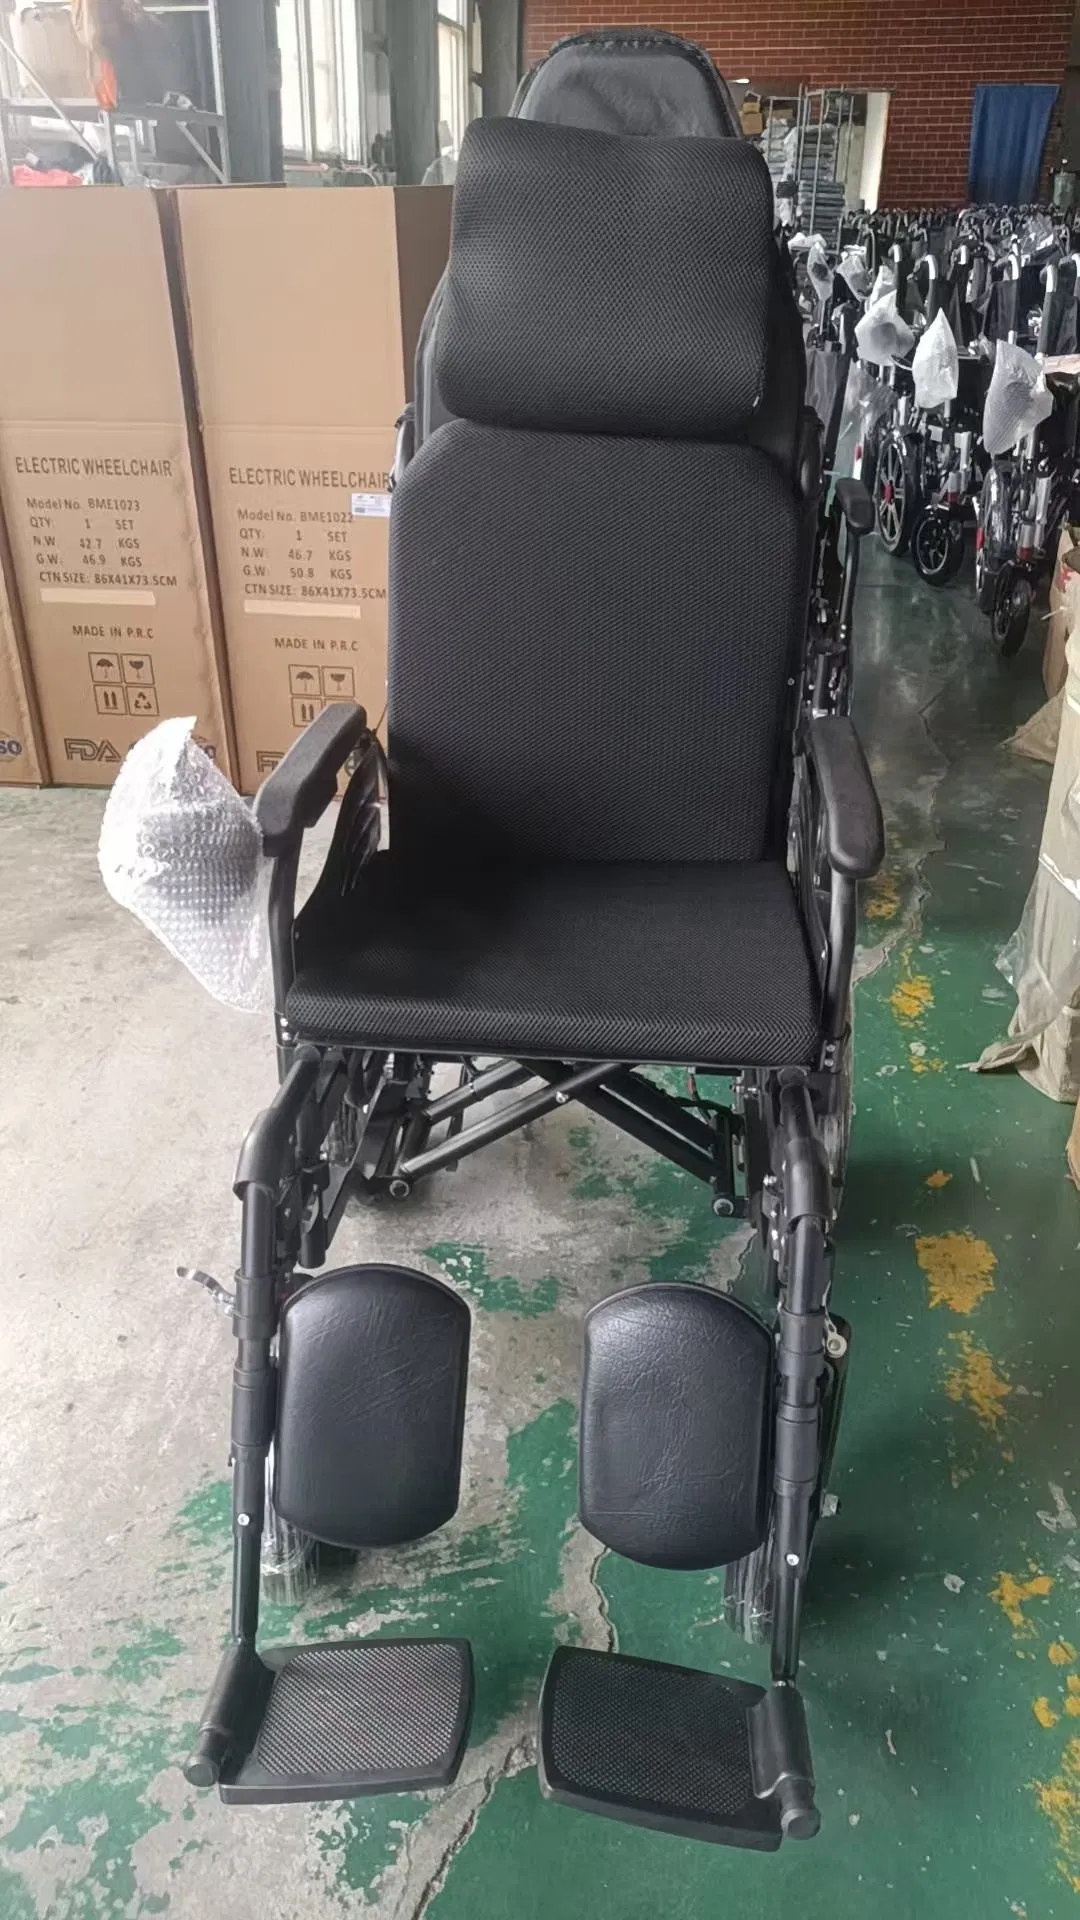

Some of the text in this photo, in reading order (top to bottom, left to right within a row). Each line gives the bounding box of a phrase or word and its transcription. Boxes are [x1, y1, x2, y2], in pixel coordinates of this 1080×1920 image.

[16, 456, 173, 477] ELECTRIC WHEELCHAIR
[229, 467, 296, 487] ELECTRIC
[26, 498, 62, 510] Model
[88, 498, 140, 512] BME1023
[237, 508, 274, 522] Model
[84, 518, 91, 529] 1
[115, 519, 135, 531] SET
[296, 530, 303, 541] 1
[327, 531, 348, 543] SET
[79, 538, 102, 549] 42.7
[118, 538, 140, 550] KGS
[82, 554, 106, 567] 46.9
[120, 556, 143, 568] KGS
[288, 550, 313, 562] 46.7
[328, 550, 352, 563] KGS
[39, 571, 62, 583] CTN
[289, 567, 315, 579] 50.8
[330, 568, 353, 581] KGS
[244, 583, 267, 595] CTN
[72, 625, 105, 638] MADE
[110, 627, 122, 637] IN
[274, 637, 309, 650] MADE
[312, 639, 326, 650] IN
[0, 740, 22, 756] SO
[63, 738, 122, 763] FDA
